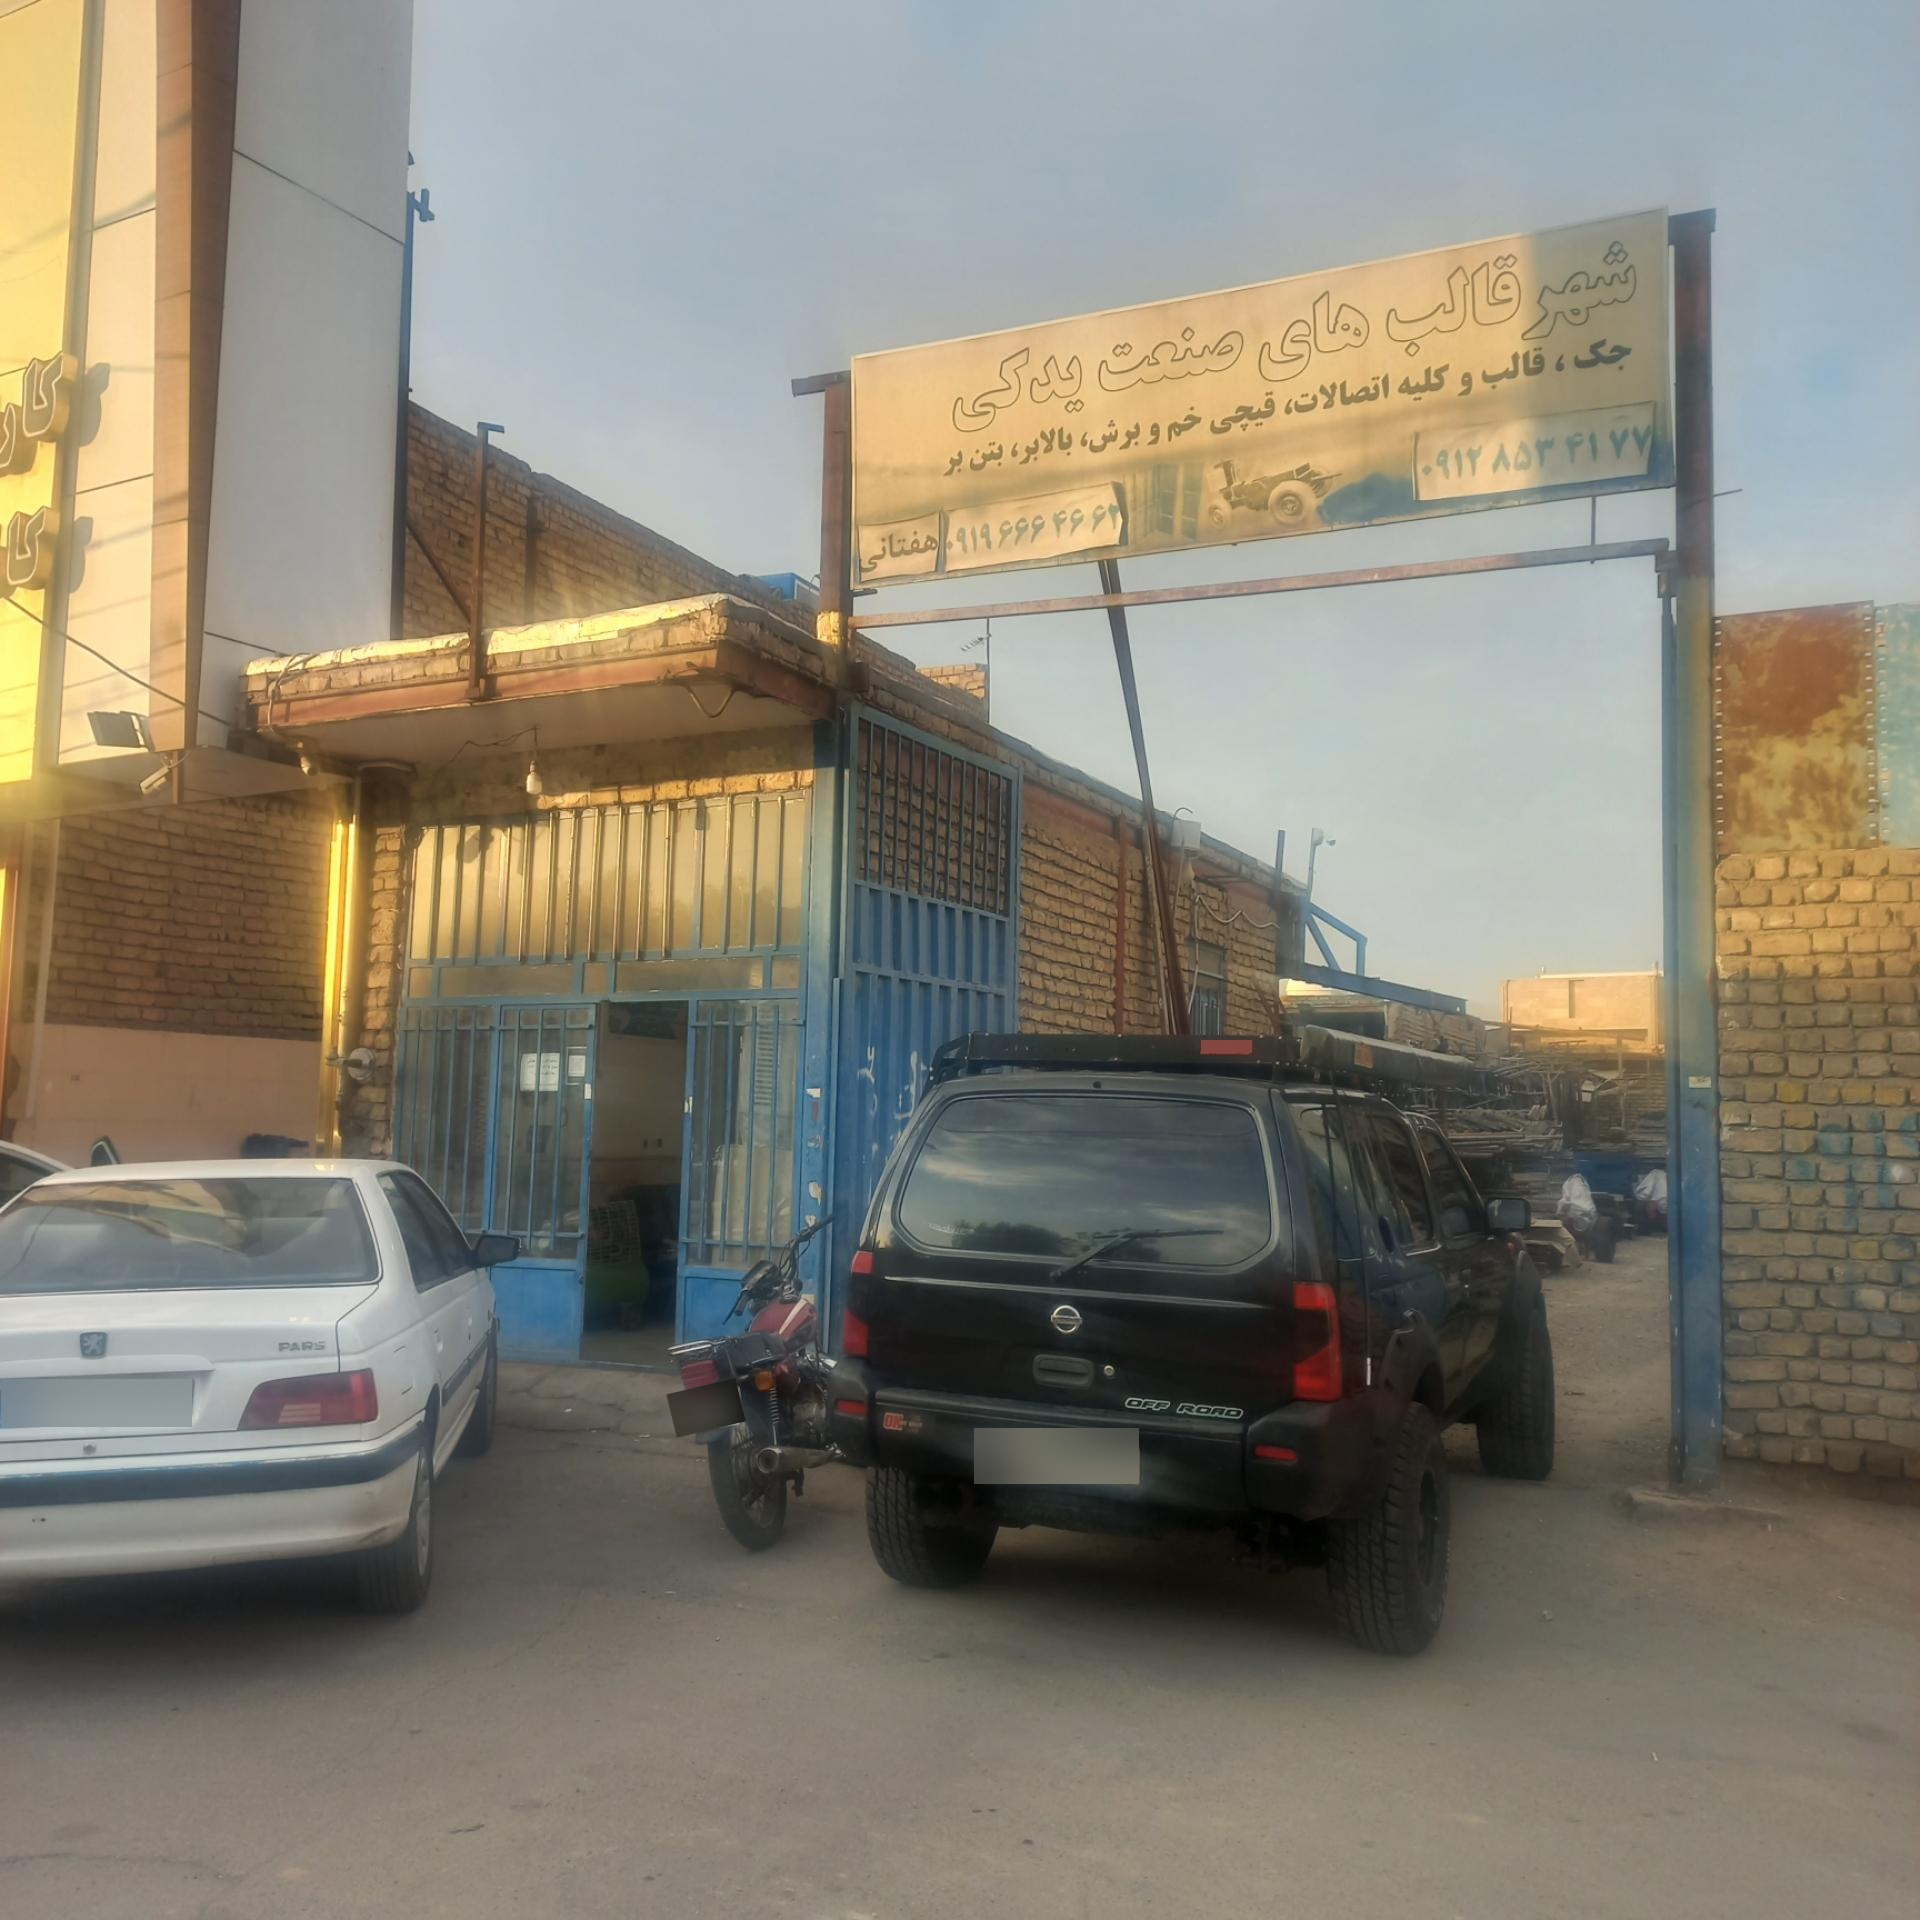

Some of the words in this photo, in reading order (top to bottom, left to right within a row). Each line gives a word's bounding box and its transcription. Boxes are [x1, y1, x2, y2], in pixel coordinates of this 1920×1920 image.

[1385, 253, 1522, 357] قالب
[1520, 239, 1638, 341] شهر
[1258, 290, 1370, 383] های
[1573, 338, 1633, 371] جک
[1098, 326, 1244, 392] صنعت
[1481, 346, 1546, 390] قالب
[952, 346, 1084, 433] یدکی
[1283, 373, 1390, 416] اتصالات،
[1397, 363, 1450, 402] کلیه
[1457, 370, 1474, 397] و
[1167, 406, 1203, 443] خم
[1209, 391, 1276, 435] قیچی
[1080, 419, 1141, 453] برش،
[1147, 422, 1161, 446] و
[943, 449, 964, 477] بر
[968, 440, 1004, 472] بتن
[860, 530, 938, 573] هفتانی
[278, 1340, 326, 1352] PARS
[1125, 1397, 1170, 1410] OFF
[1176, 1403, 1243, 1419] ROAD
